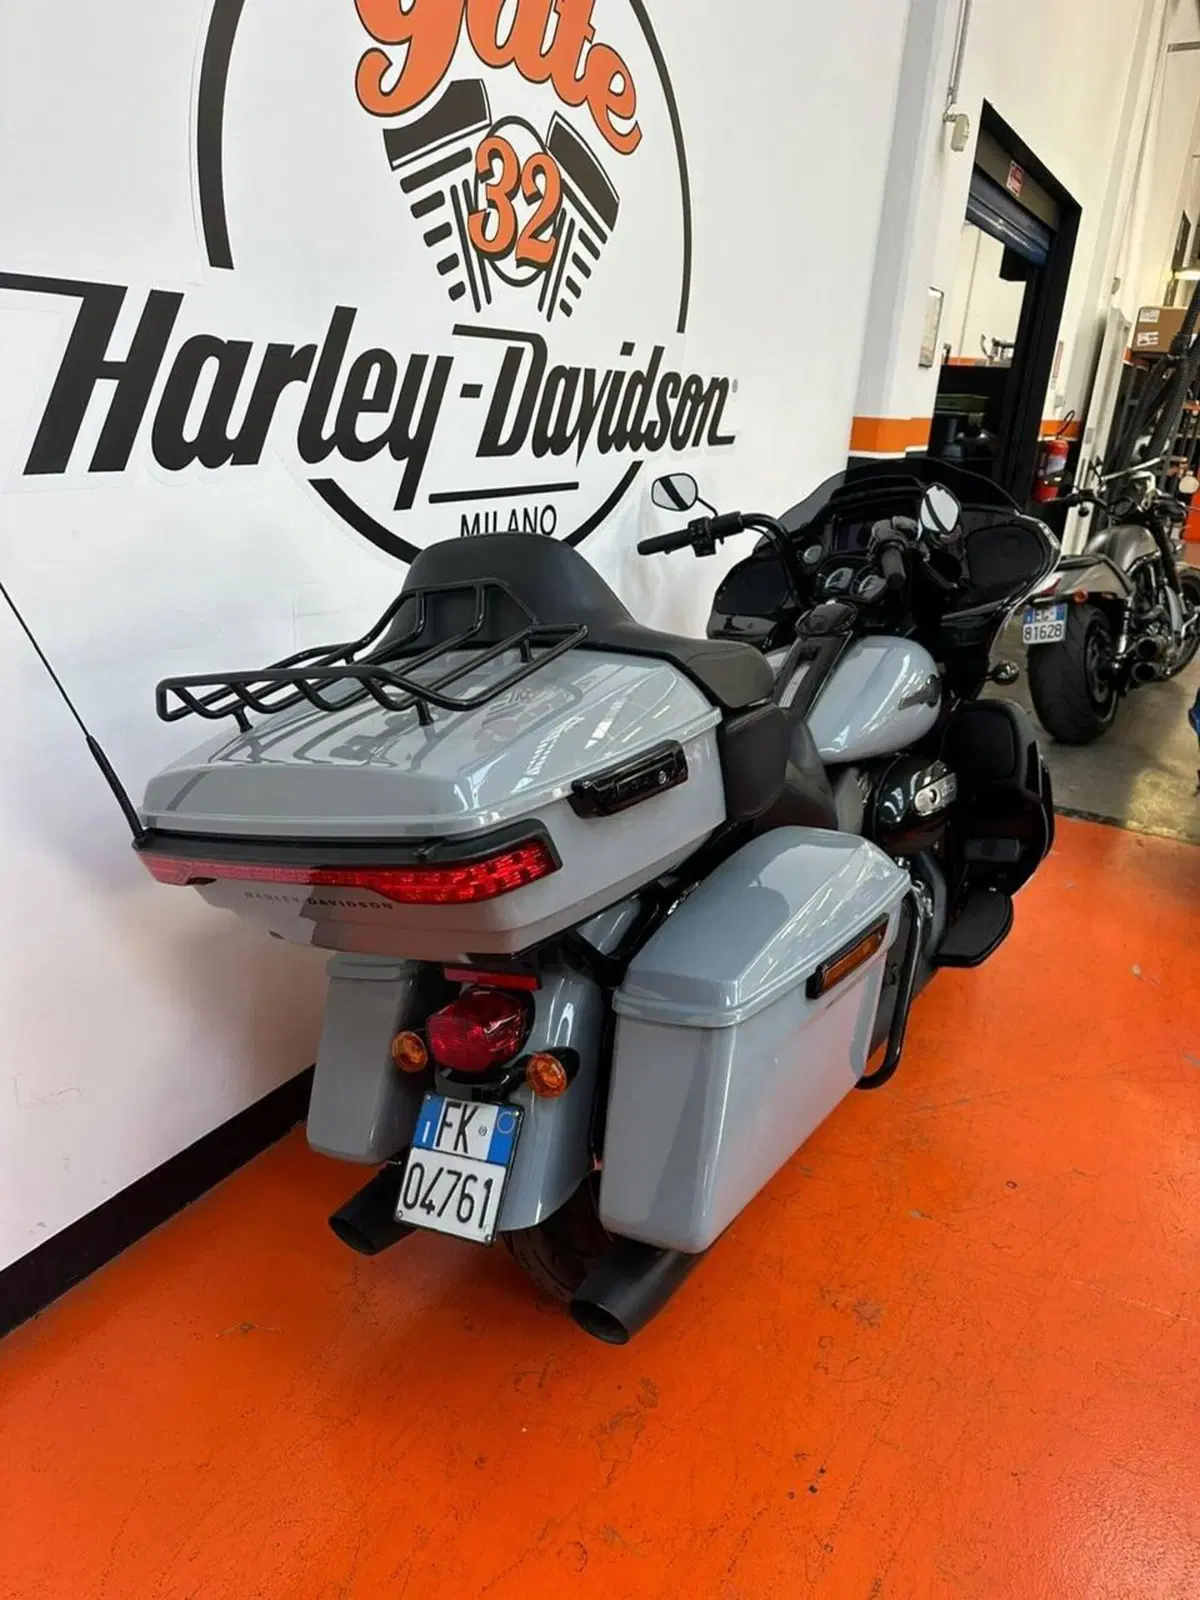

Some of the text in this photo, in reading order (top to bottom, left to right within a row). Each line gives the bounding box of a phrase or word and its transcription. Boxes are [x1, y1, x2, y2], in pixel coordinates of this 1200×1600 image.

[467, 135, 562, 268] 32
[460, 504, 557, 537] MILANO
[1024, 623, 1062, 641] 81628
[435, 1102, 479, 1154] FK
[402, 1162, 494, 1229] 04761
